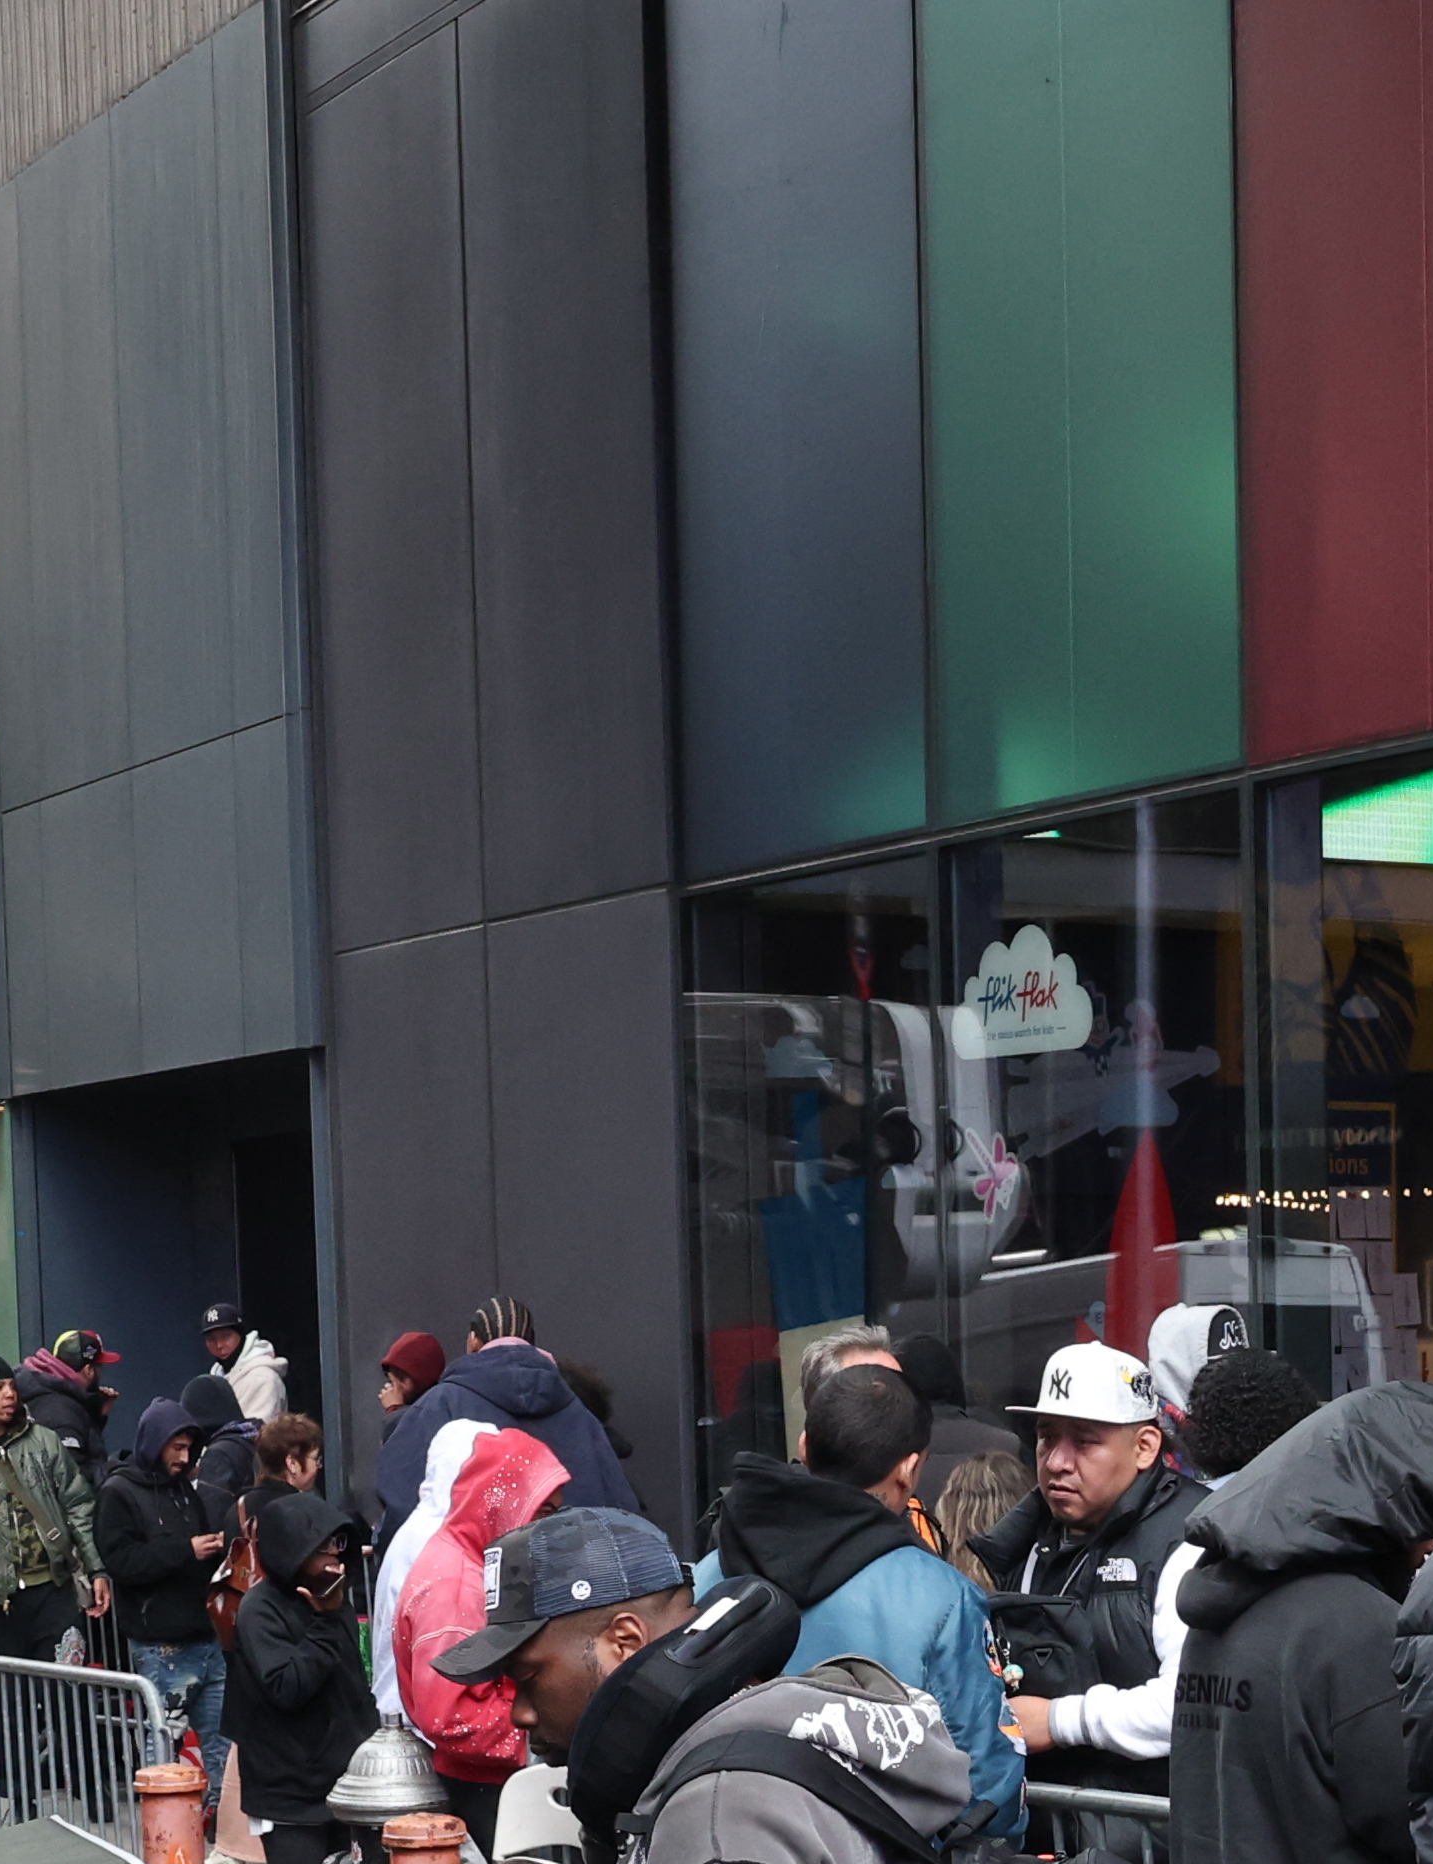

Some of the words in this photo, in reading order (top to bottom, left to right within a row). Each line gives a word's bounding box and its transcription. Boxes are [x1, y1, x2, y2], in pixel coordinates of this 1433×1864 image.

[978, 973, 1017, 1026] flik
[1016, 970, 1059, 1022] flak
[1107, 1557, 1124, 1566] THE
[1096, 1565, 1123, 1575] NORTH
[1102, 1574, 1123, 1582] FACE
